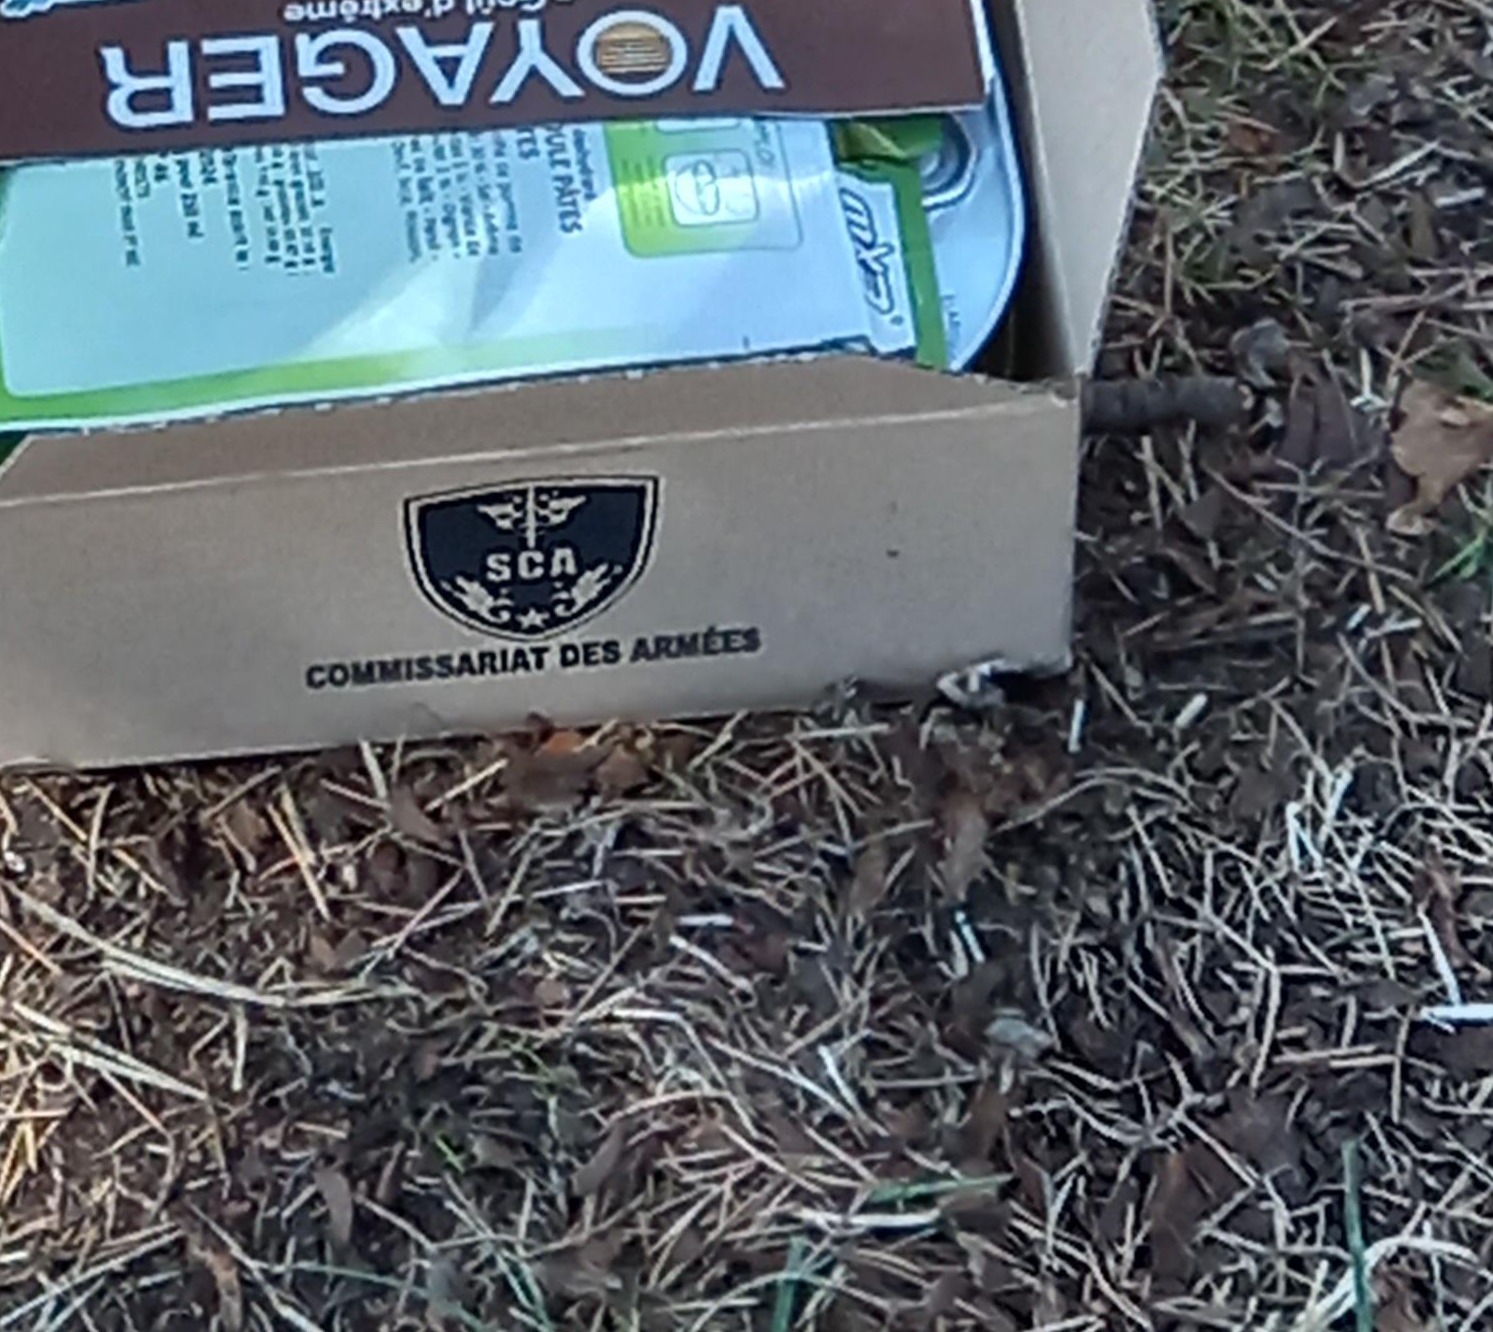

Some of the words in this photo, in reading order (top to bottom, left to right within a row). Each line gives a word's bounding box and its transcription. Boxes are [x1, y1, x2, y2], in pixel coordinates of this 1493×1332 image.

[101, 4, 786, 128] VOYAGER
[552, 175, 584, 234] PÂTES
[485, 547, 578, 583] SCA
[306, 645, 550, 690] COMMISSARIAT
[559, 639, 622, 669] DES
[630, 626, 762, 664] ARMÉES
